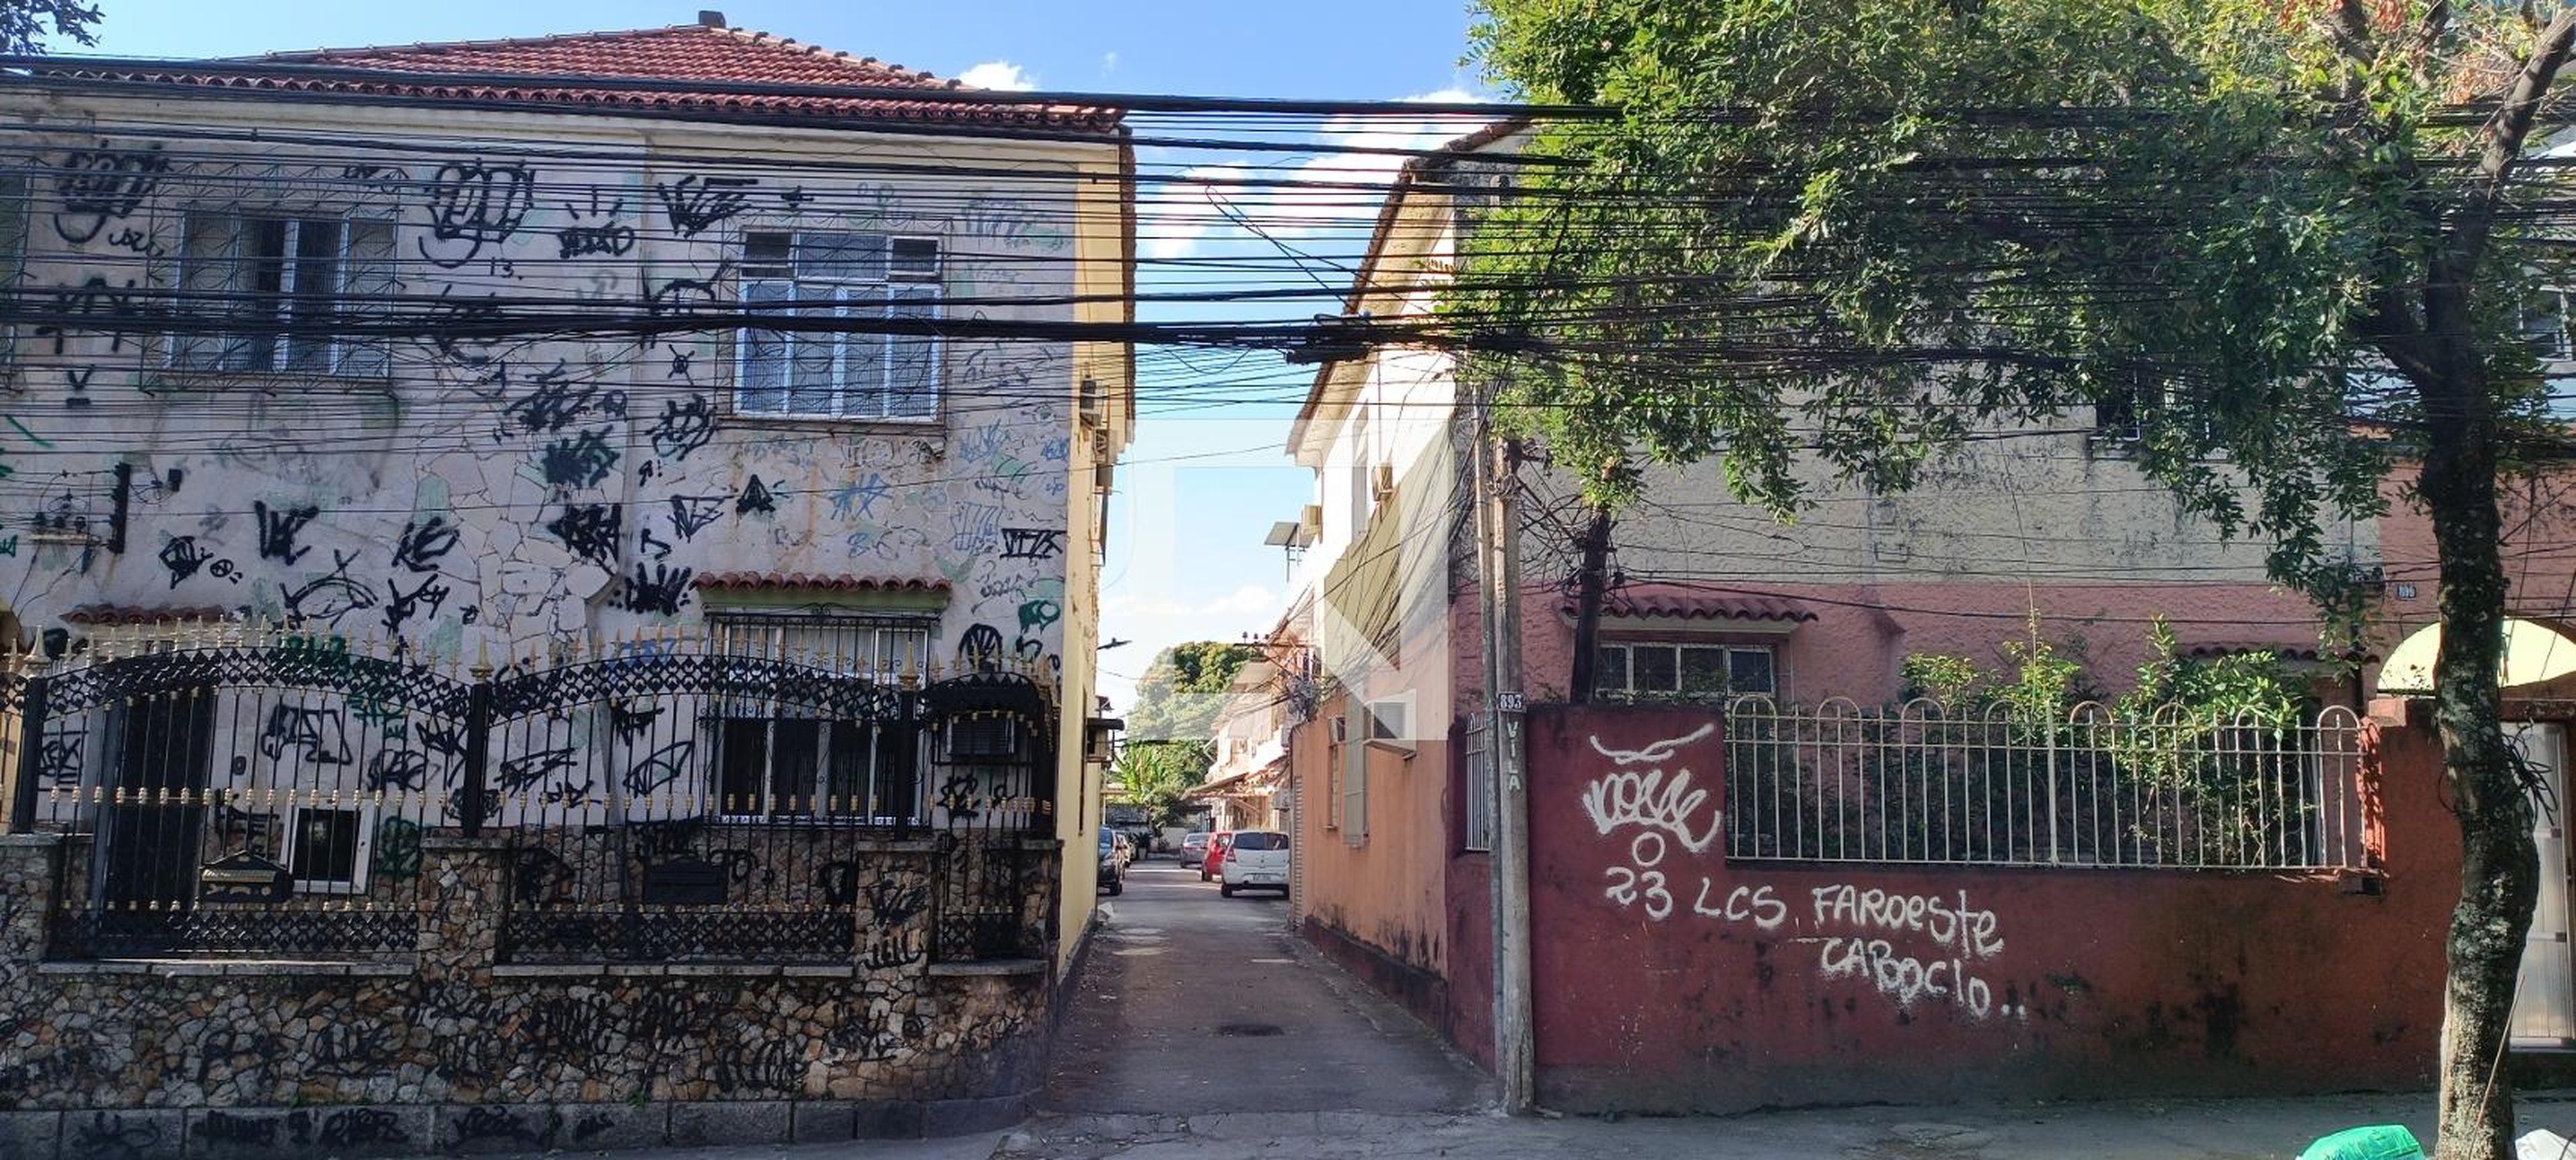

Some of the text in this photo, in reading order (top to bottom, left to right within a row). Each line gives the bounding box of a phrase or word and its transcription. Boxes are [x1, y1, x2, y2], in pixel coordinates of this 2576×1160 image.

[1499, 694, 1521, 708] 893
[1507, 721, 1521, 790] VILA
[1606, 866, 1673, 919] 23
[1694, 877, 1786, 927] LCS
